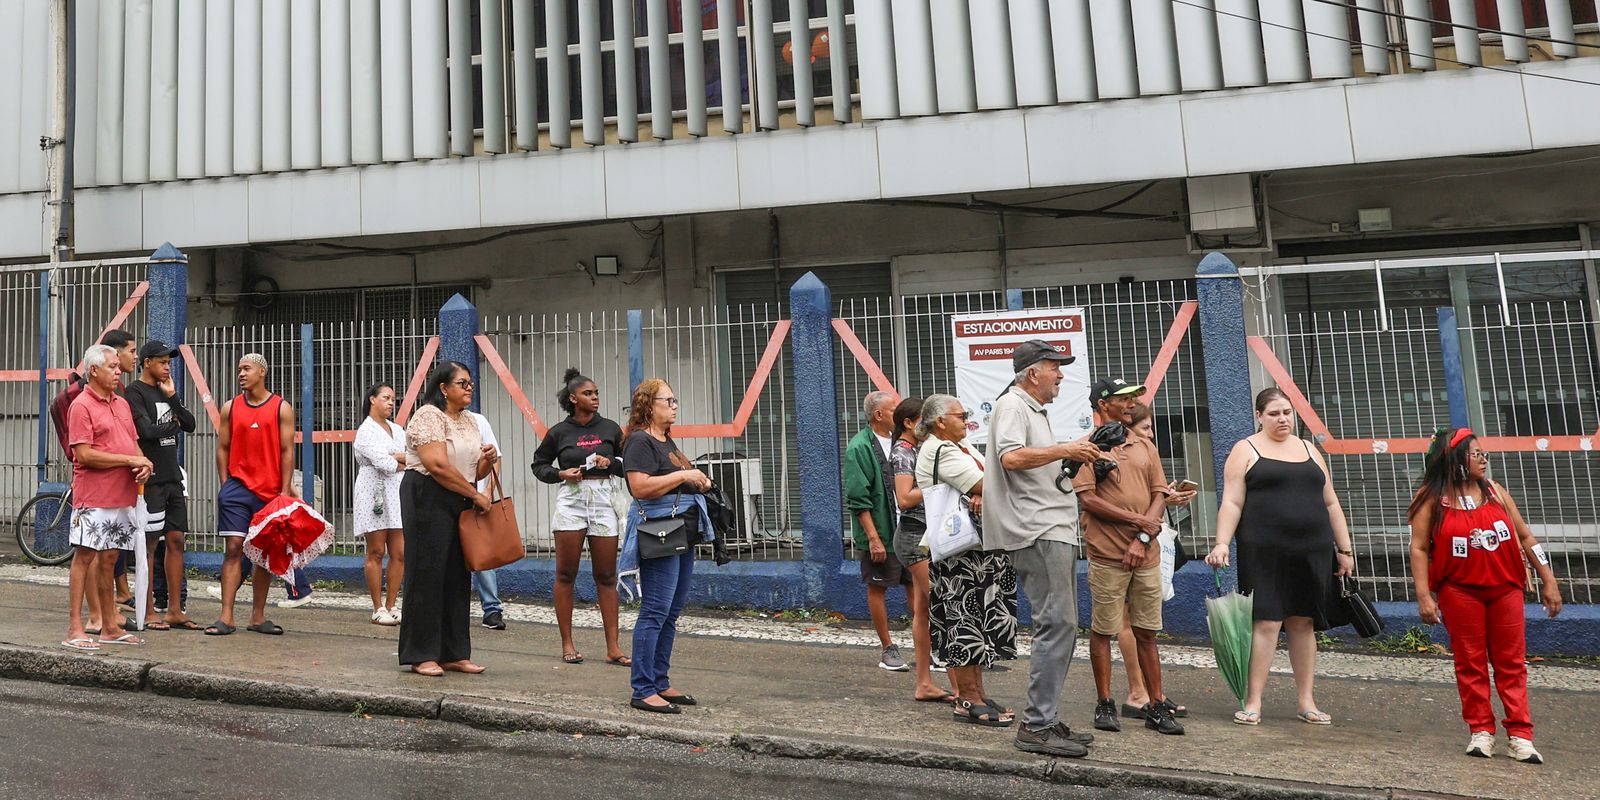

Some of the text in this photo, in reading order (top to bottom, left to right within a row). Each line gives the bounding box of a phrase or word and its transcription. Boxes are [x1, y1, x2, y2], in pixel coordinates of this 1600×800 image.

[963, 318, 1073, 334] ESTACIONAMENTO
[1499, 530, 1509, 538] 13
[1486, 535, 1497, 545] 13
